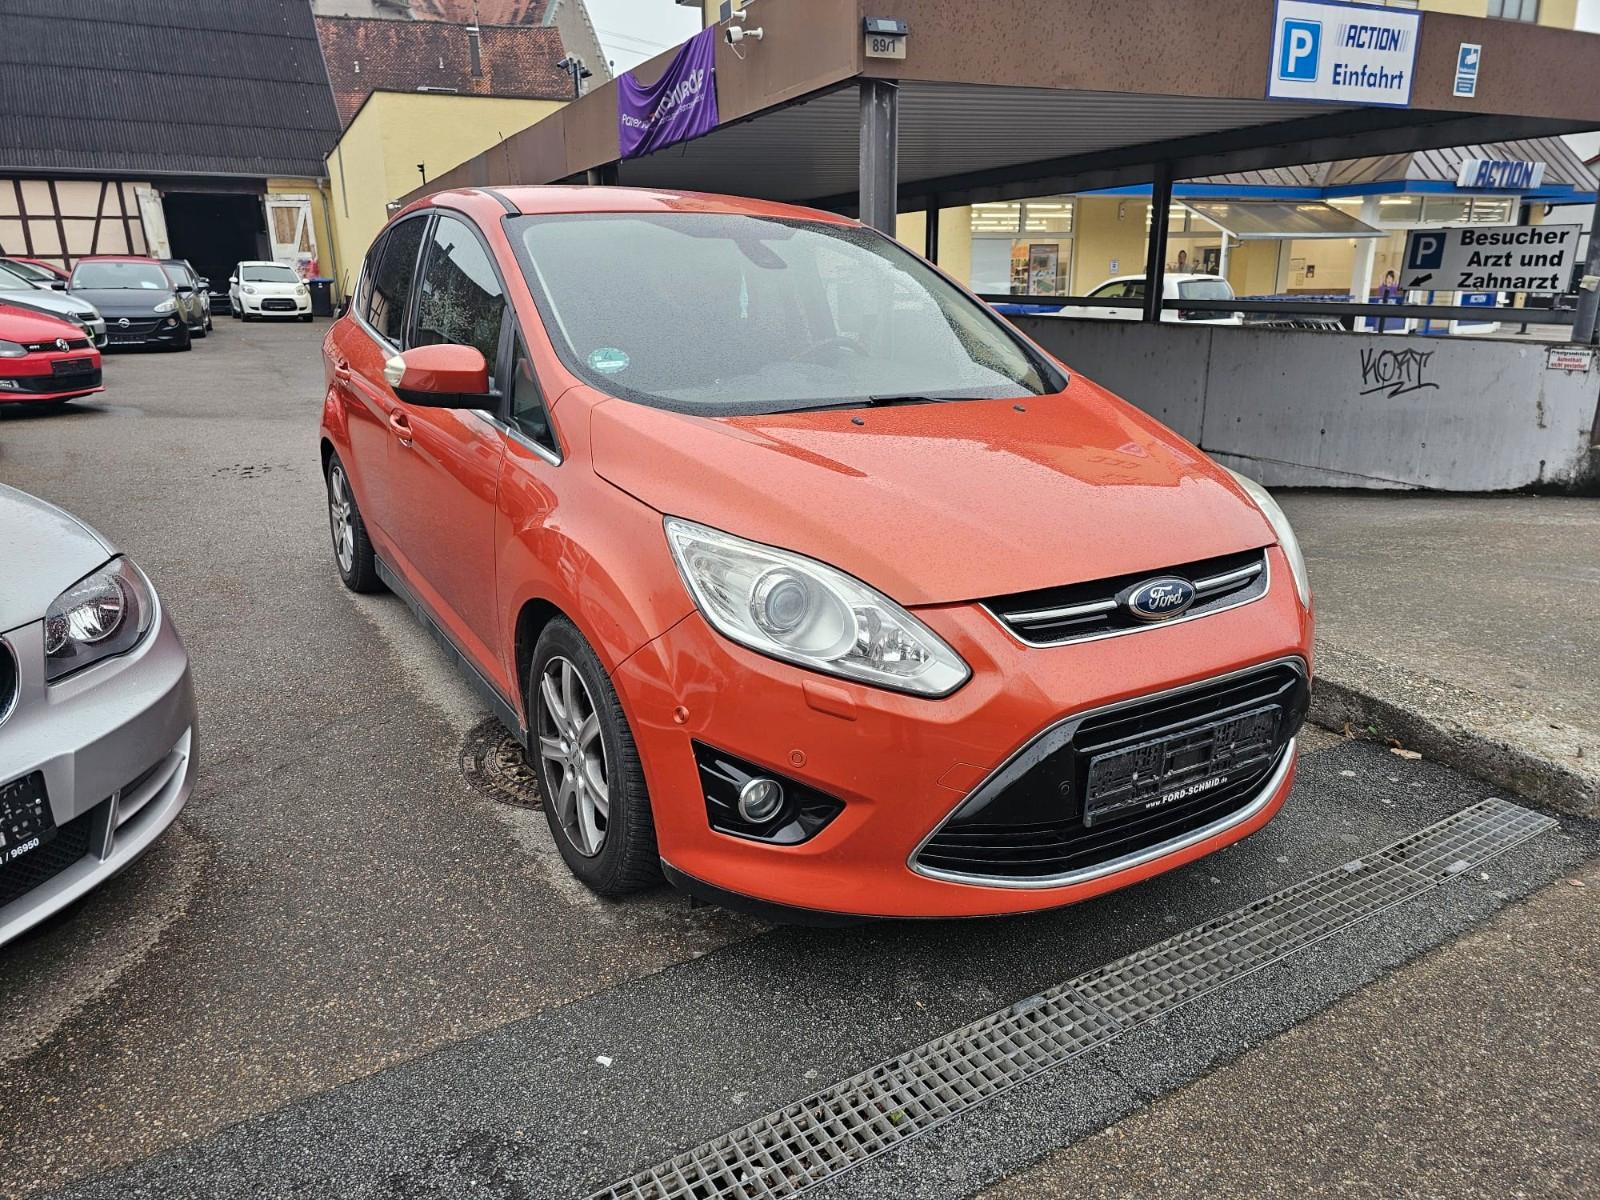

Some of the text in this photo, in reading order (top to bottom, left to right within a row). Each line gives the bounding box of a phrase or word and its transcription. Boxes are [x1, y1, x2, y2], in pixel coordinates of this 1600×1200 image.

[872, 38, 896, 53] 89/1
[1287, 28, 1313, 73] P
[1345, 24, 1401, 52] ACTION
[1332, 63, 1404, 90] Einfahrt
[1475, 160, 1535, 187] ACTION
[1460, 228, 1570, 246] Besucher
[1416, 237, 1437, 265] P
[1466, 250, 1565, 267] Arzt und
[1457, 272, 1559, 290] Zahnarzt
[1149, 585, 1183, 610] Ford
[10, 837, 39, 858] 96950
